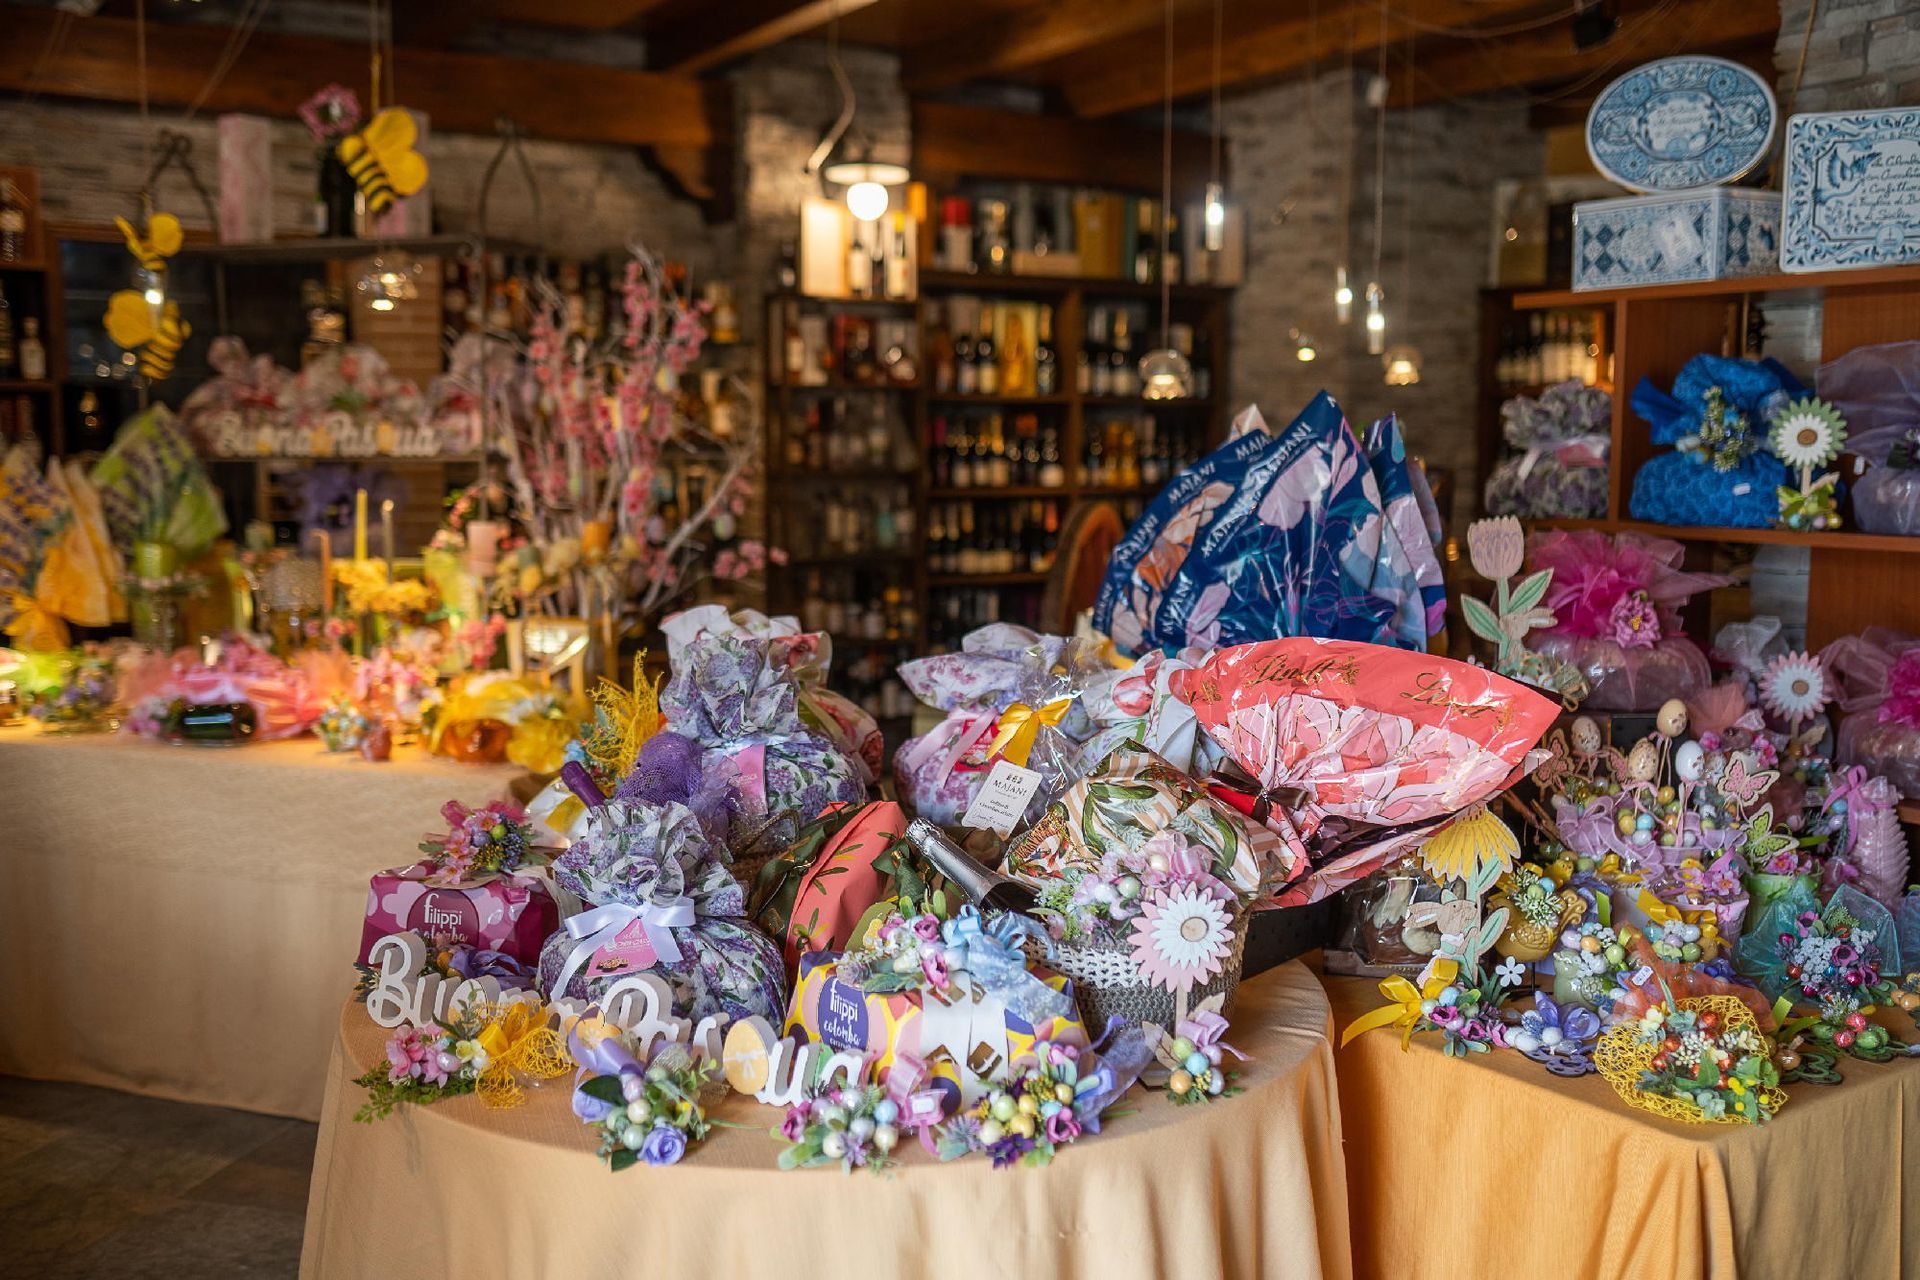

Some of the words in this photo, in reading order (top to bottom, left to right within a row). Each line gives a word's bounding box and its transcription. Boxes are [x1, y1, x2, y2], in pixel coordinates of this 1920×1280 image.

[1235, 433, 1275, 462] MAJA
[1246, 654, 1338, 688] Lindt
[993, 779, 1027, 798] MAJANI
[424, 893, 463, 929] filippi
[829, 978, 858, 1025] filippi
[823, 1016, 861, 1047] colomba
